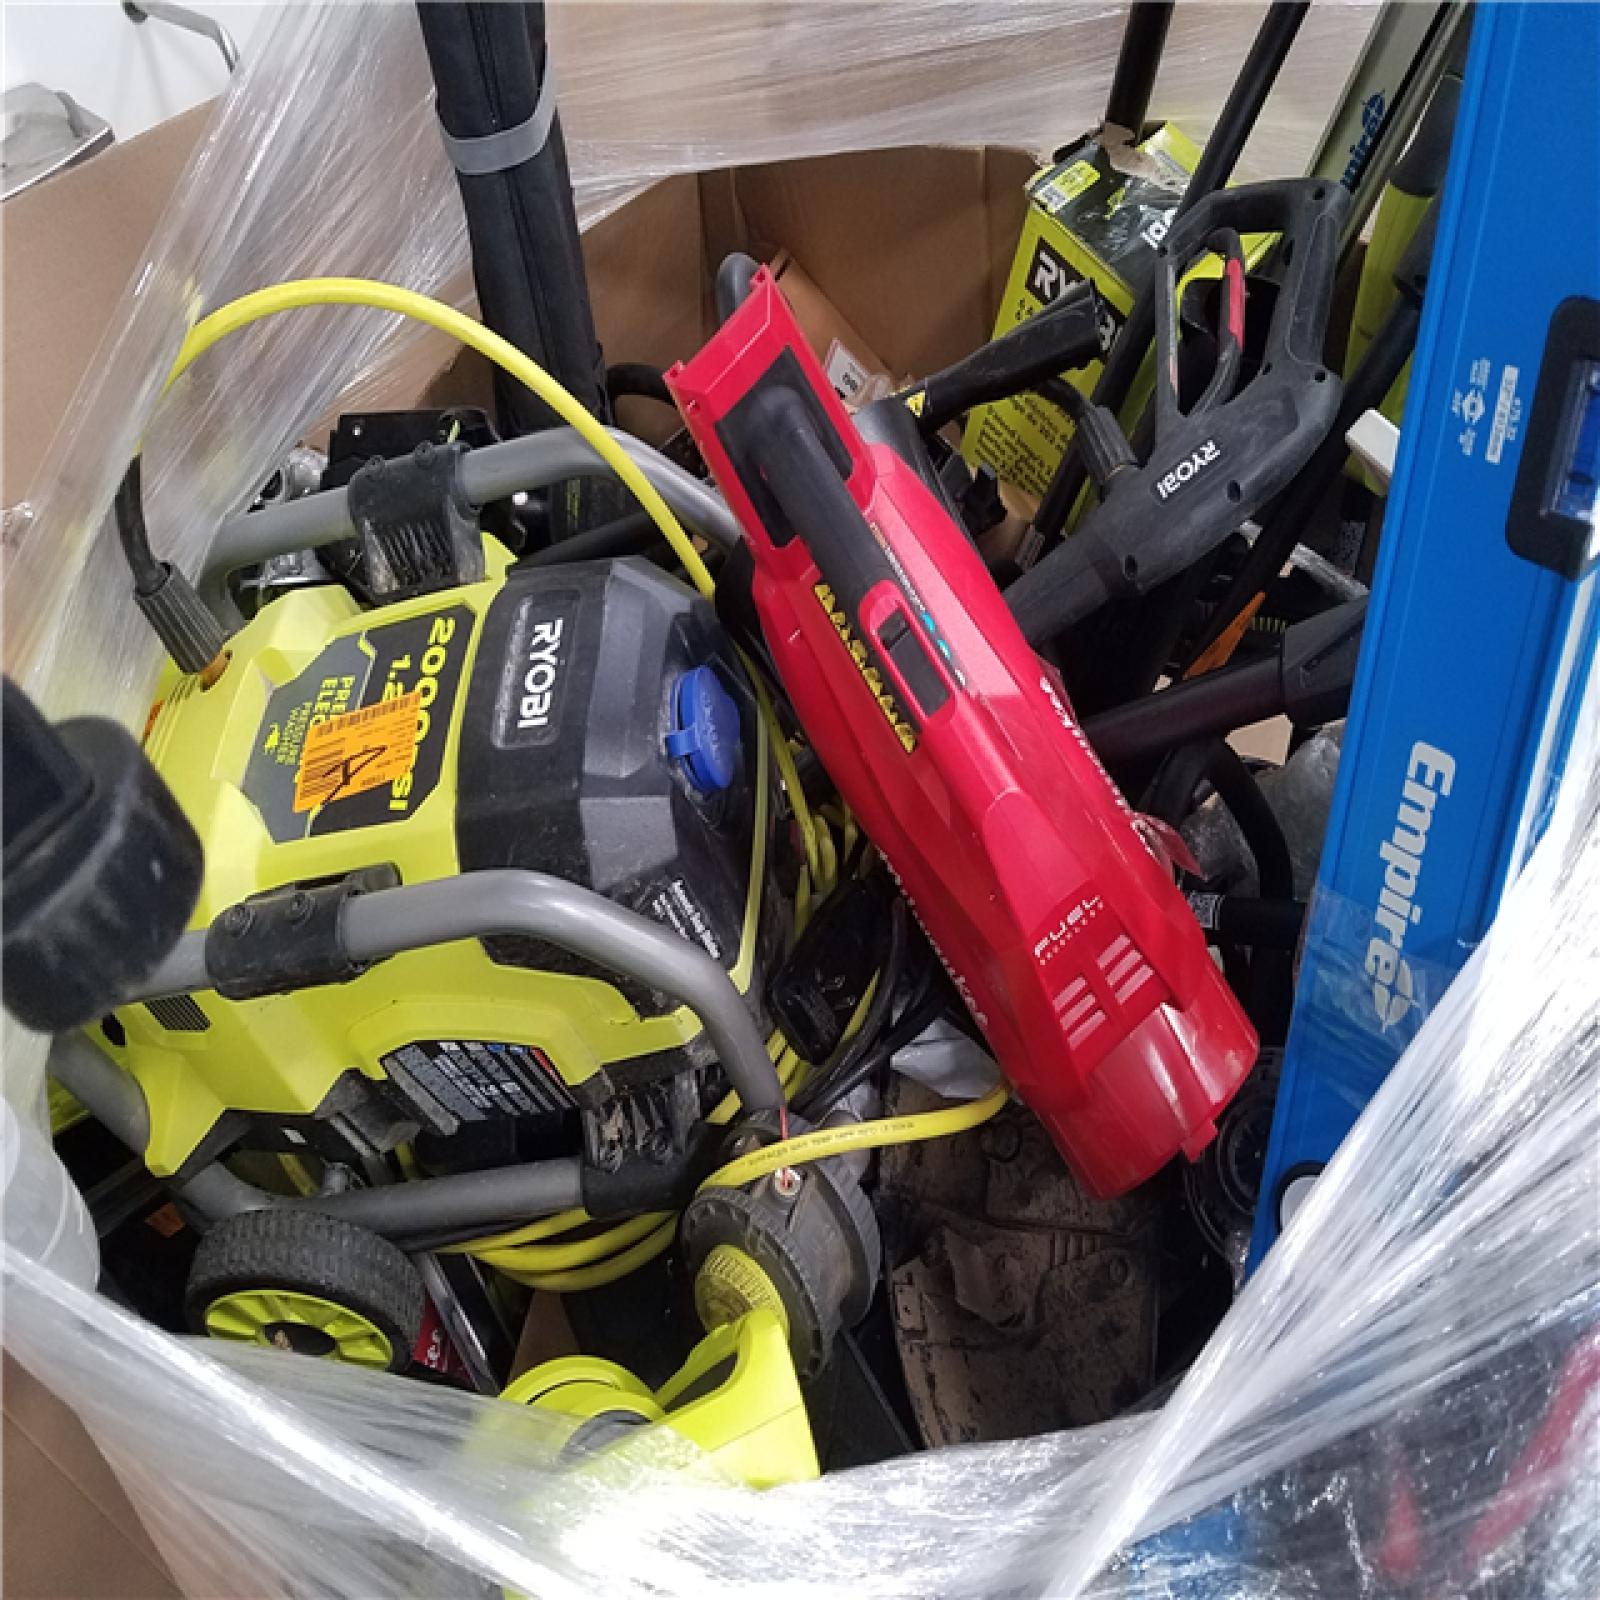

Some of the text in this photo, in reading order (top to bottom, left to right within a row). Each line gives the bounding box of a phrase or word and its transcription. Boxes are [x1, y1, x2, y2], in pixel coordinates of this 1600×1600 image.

[1156, 439, 1221, 499] RYOBI
[516, 617, 563, 729] RYOBI
[1364, 740, 1456, 985] Empire
